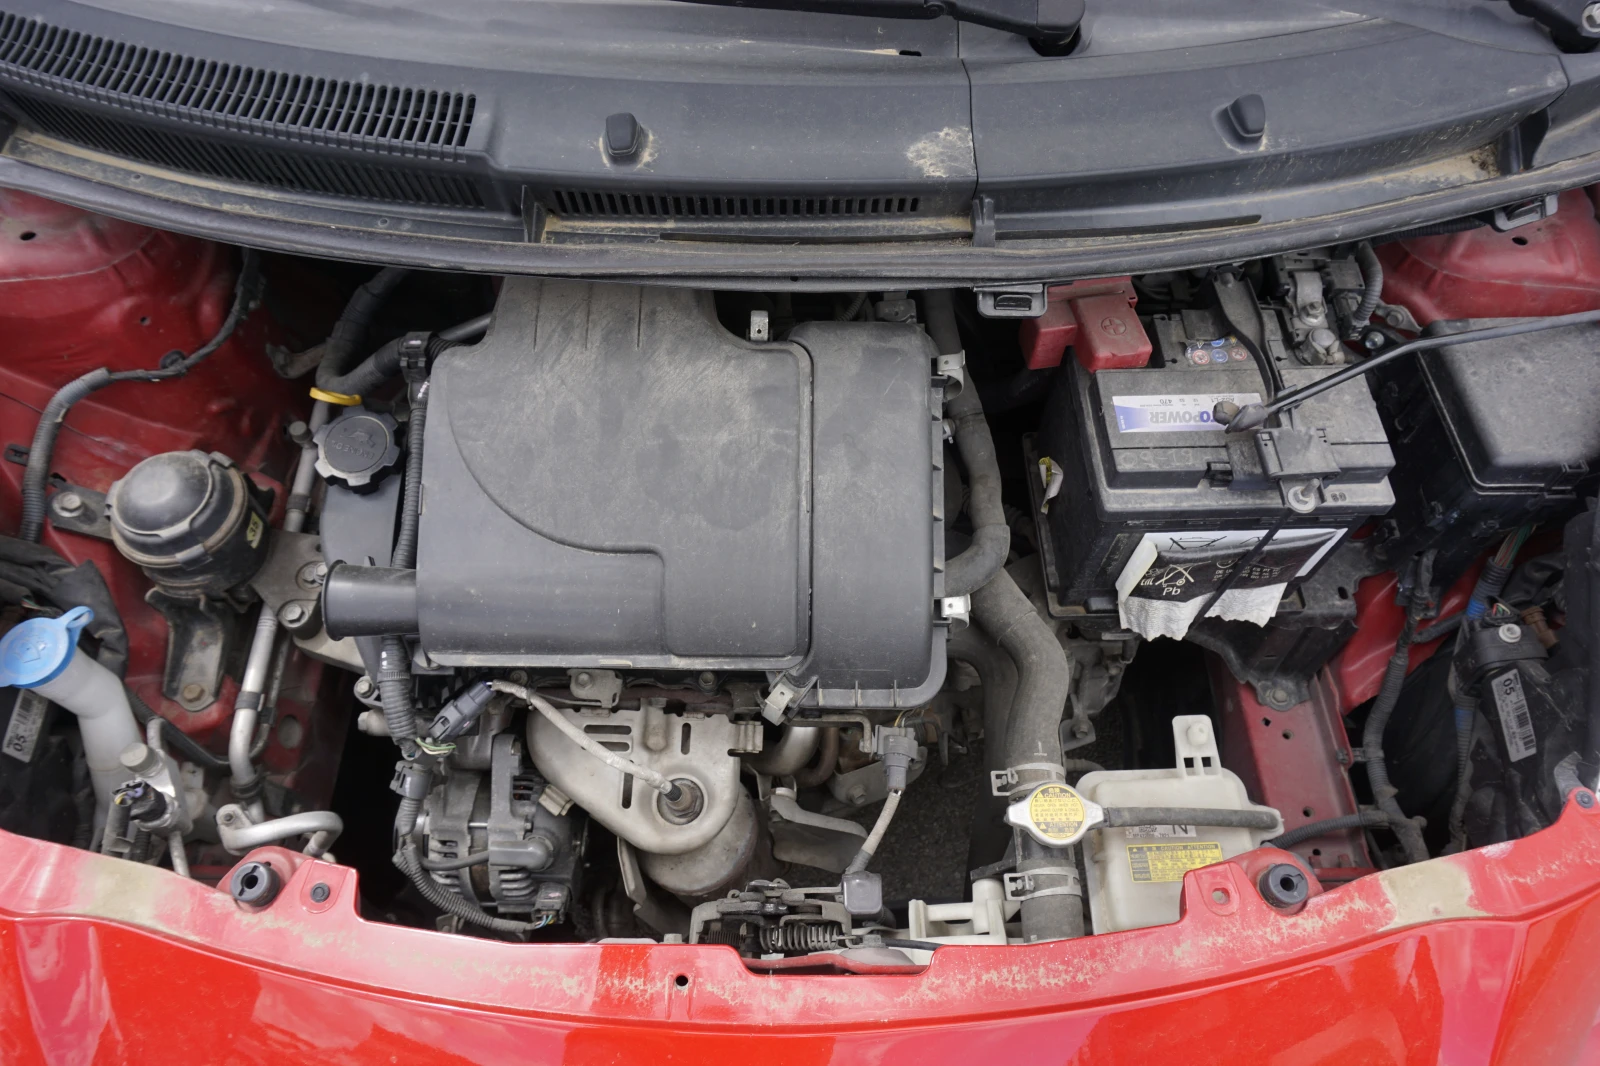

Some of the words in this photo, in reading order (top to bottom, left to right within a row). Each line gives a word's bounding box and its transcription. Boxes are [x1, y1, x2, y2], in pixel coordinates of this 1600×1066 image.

[1162, 586, 1180, 596] Pb
[1503, 678, 1515, 696] 05
[12, 734, 27, 752] 05
